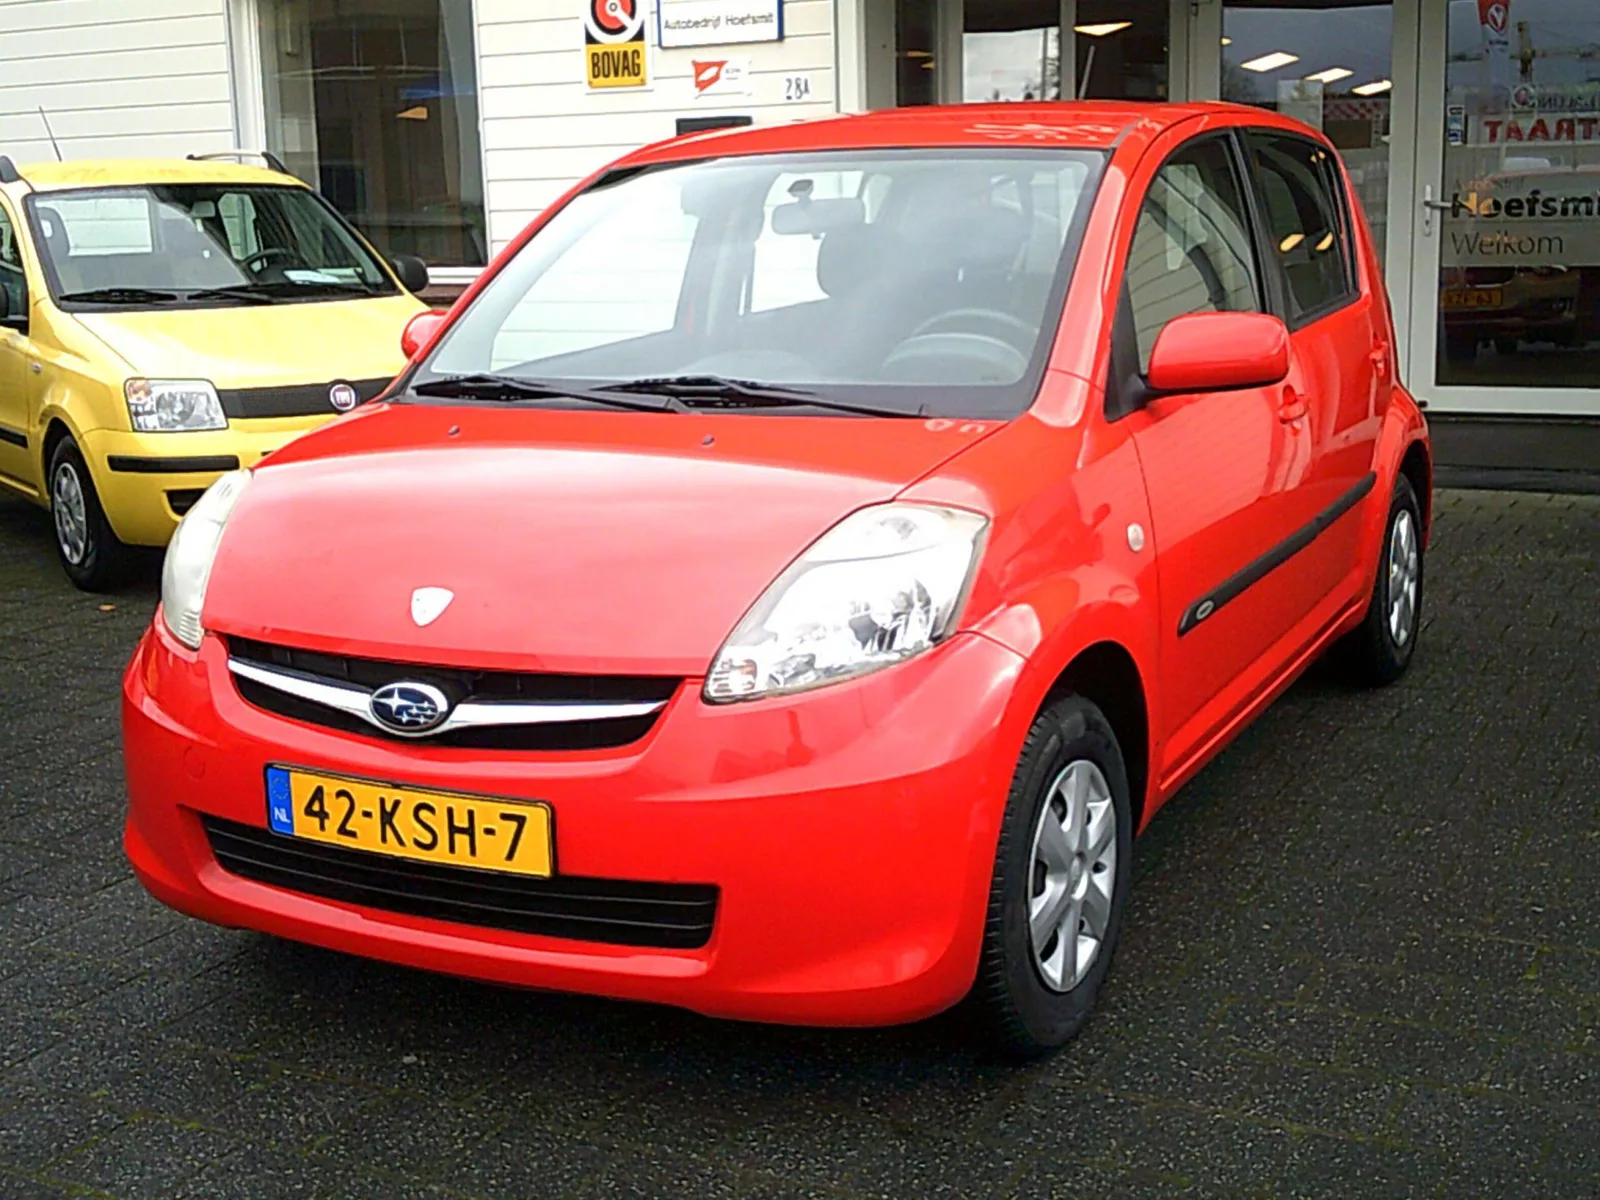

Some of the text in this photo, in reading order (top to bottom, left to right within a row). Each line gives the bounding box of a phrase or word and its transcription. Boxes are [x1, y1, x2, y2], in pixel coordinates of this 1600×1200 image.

[664, 12, 774, 30] Autobedrijf Hoefsmit
[591, 50, 641, 79] BOVAG
[785, 77, 810, 100] 28A
[273, 806, 291, 824] NL
[303, 784, 528, 862] 42-KSH-7
